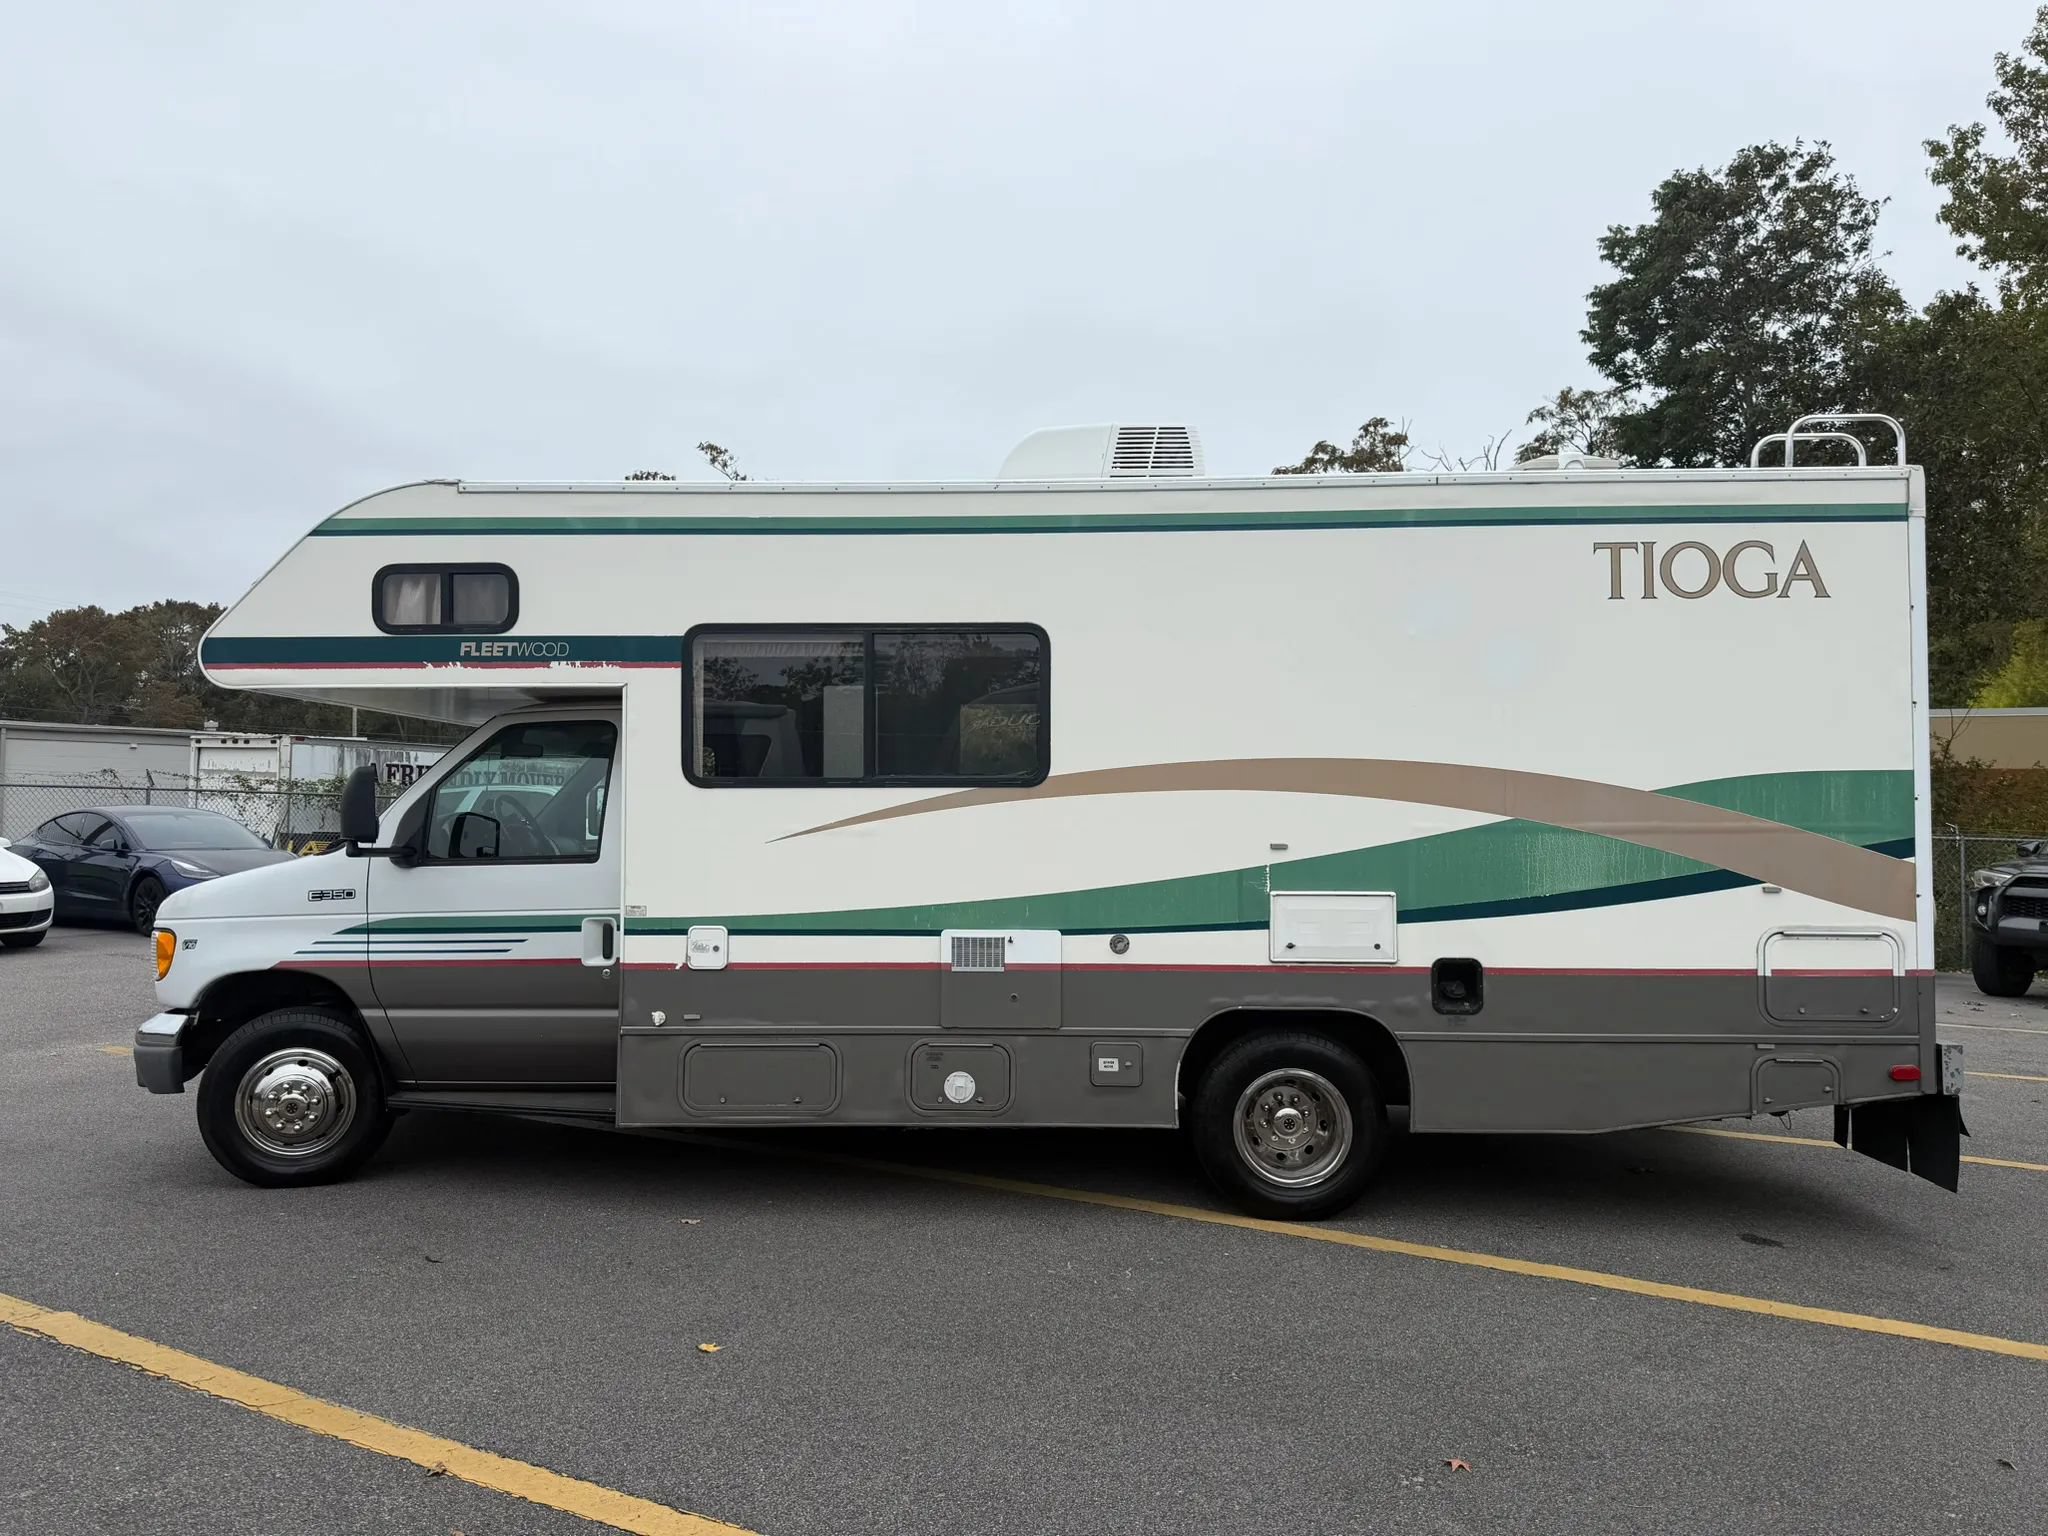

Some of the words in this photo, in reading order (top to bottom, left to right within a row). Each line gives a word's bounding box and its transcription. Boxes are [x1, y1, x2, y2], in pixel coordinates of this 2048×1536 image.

[1593, 539, 1831, 599] TIOGA
[460, 642, 569, 656] FLEETWOOD
[308, 889, 356, 901] E350
